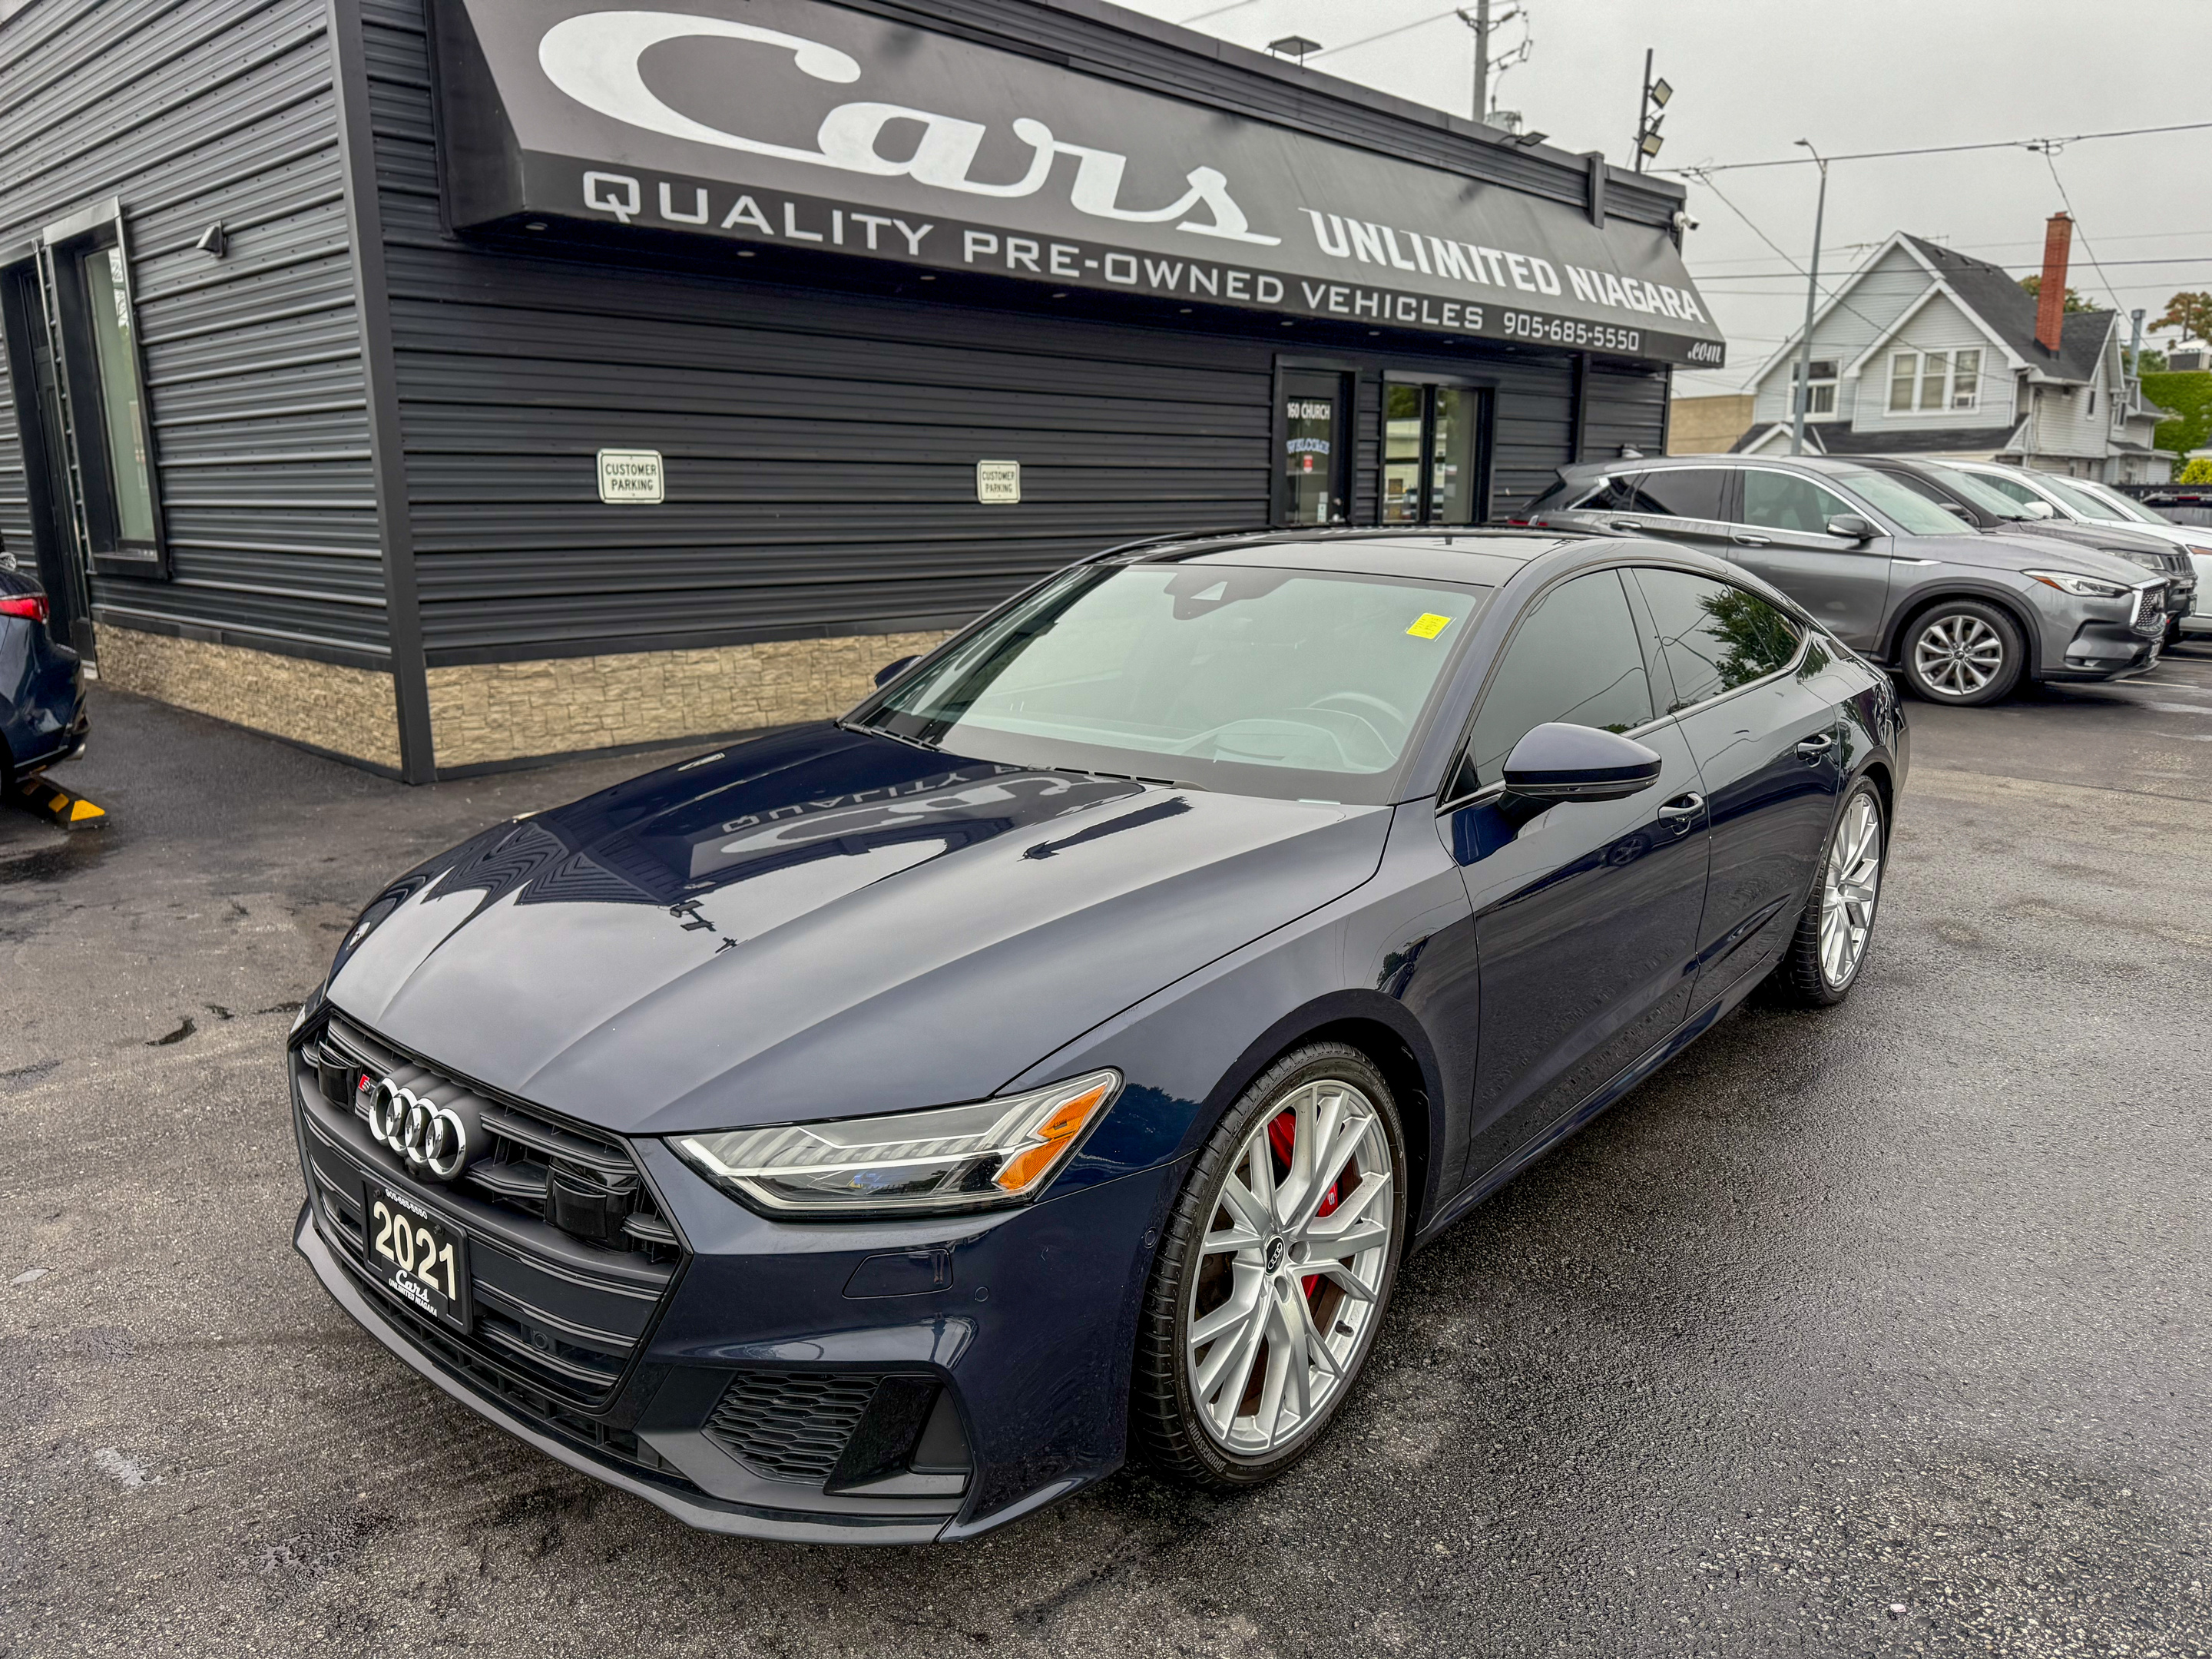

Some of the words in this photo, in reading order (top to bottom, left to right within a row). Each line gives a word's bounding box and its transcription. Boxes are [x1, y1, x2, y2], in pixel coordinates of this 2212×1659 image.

[538, 10, 1282, 247] Cars
[582, 171, 935, 256] QUALITY
[963, 230, 1284, 304] PRE-OWNED
[1300, 281, 1484, 330] VEHICLES
[1297, 207, 1562, 296] UNLIMITED
[1564, 263, 1708, 324] NIAGARA
[1687, 341, 1722, 363] .com
[1286, 402, 1300, 419] 160
[1301, 402, 1331, 420] CHURCH
[1286, 437, 1330, 455] WELCOME
[604, 462, 657, 476] CUSTOMER
[982, 471, 1015, 481] CUSTOMER
[611, 478, 654, 492] PARKING
[985, 483, 1013, 493] PARKING
[373, 1200, 456, 1301] 2021
[389, 1278, 415, 1301] UNLIMITED
[415, 1296, 438, 1317] NIAGARA
[396, 1270, 430, 1303] Cars
[1187, 1418, 1227, 1473] BRIDGESTONE
